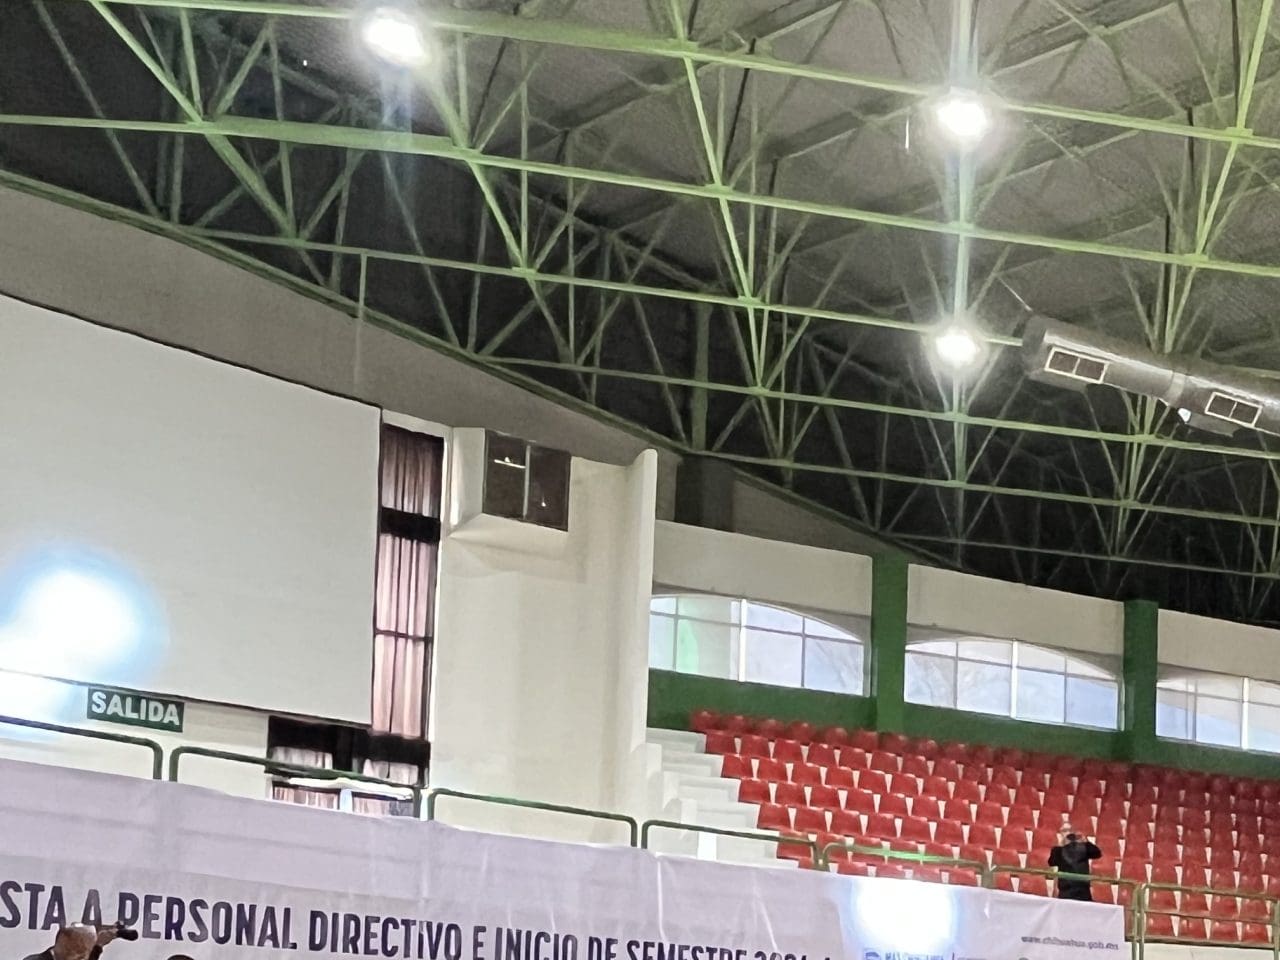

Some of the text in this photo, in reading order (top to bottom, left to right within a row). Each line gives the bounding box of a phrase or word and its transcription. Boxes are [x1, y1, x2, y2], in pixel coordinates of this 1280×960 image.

[91, 691, 180, 726] SALIDA
[81, 888, 103, 928] A
[118, 892, 298, 950] PERSONAL
